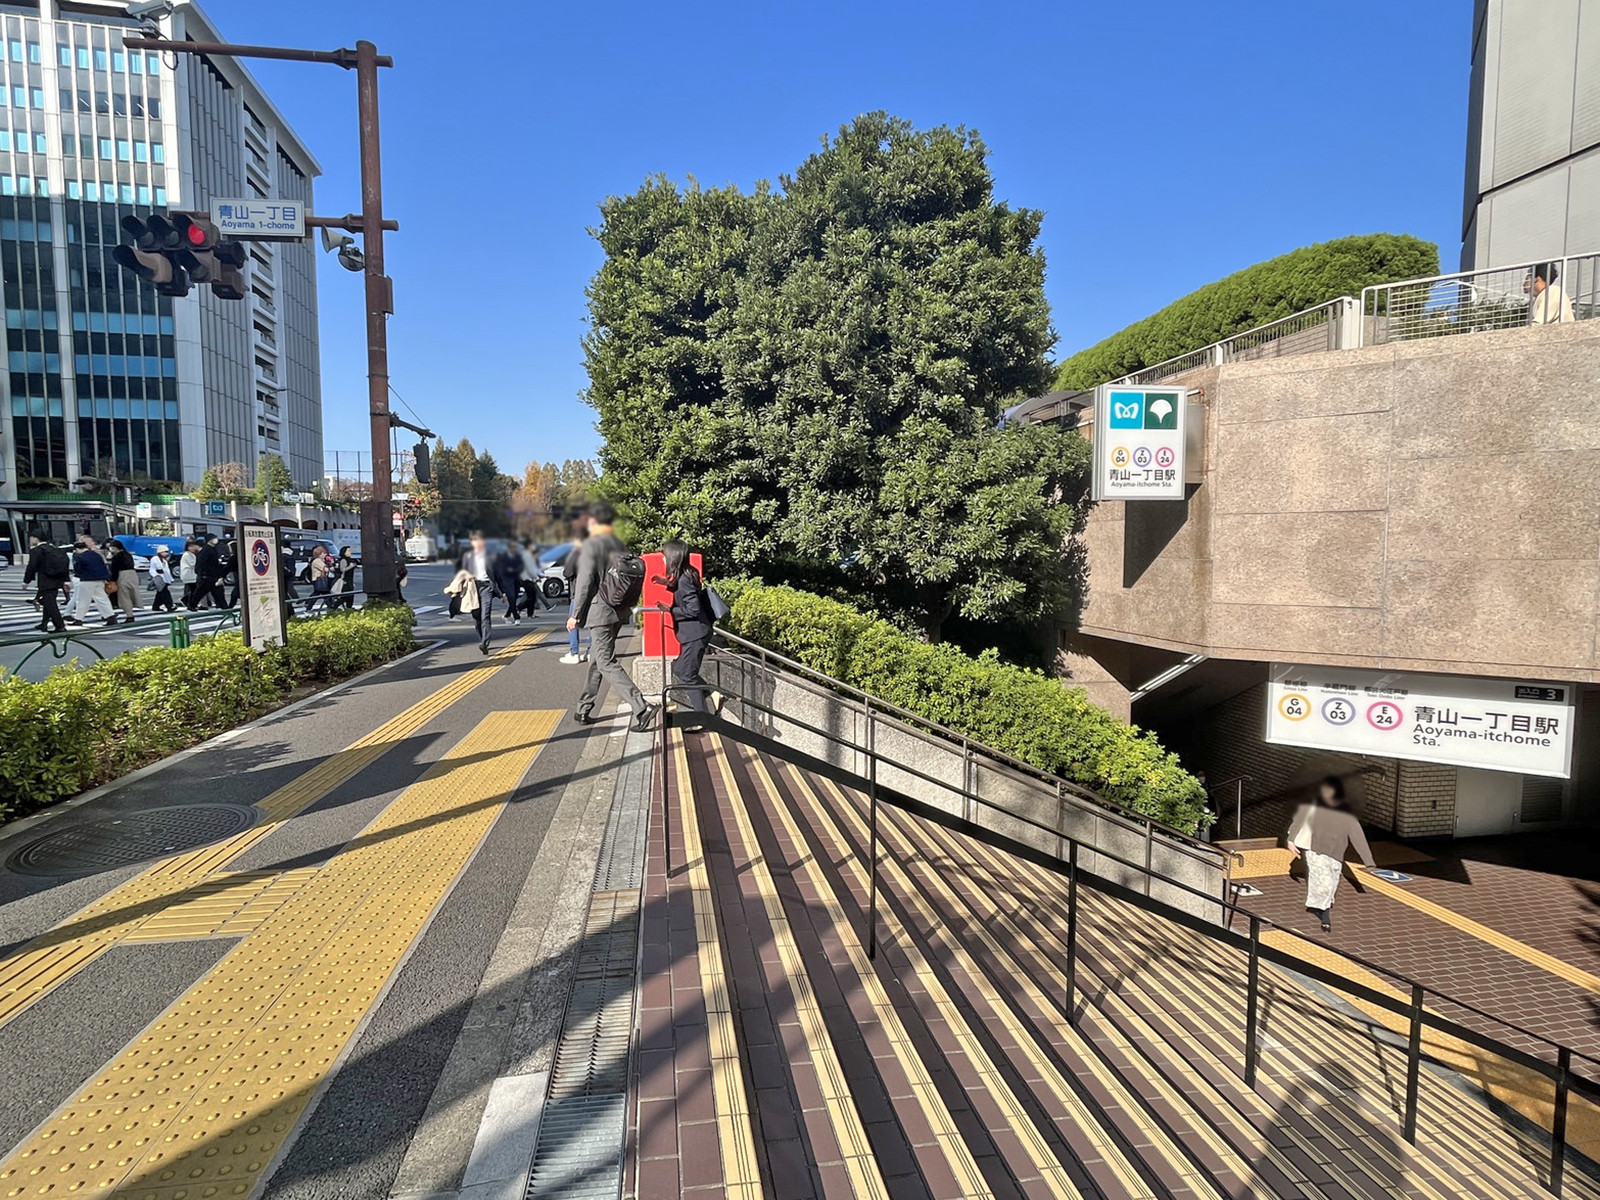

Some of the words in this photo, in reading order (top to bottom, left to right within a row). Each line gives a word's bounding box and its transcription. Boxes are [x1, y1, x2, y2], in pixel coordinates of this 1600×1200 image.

[218, 204, 296, 221] 青山一丁目
[221, 220, 255, 229] Aoyama
[259, 221, 295, 229] 1-chome
[1109, 469, 1176, 481] 青山一丁目駅
[1546, 689, 1556, 700] 3
[1290, 698, 1299, 706] G
[1335, 702, 1343, 710] Z
[1286, 706, 1302, 715] 04
[1381, 706, 1388, 715] E
[1330, 711, 1346, 720] 03
[1376, 715, 1393, 724] 24
[1414, 705, 1559, 735] 青山一丁目駅
[1413, 723, 1551, 747] Aoyama-itchome
[1413, 734, 1441, 747] Sta.
